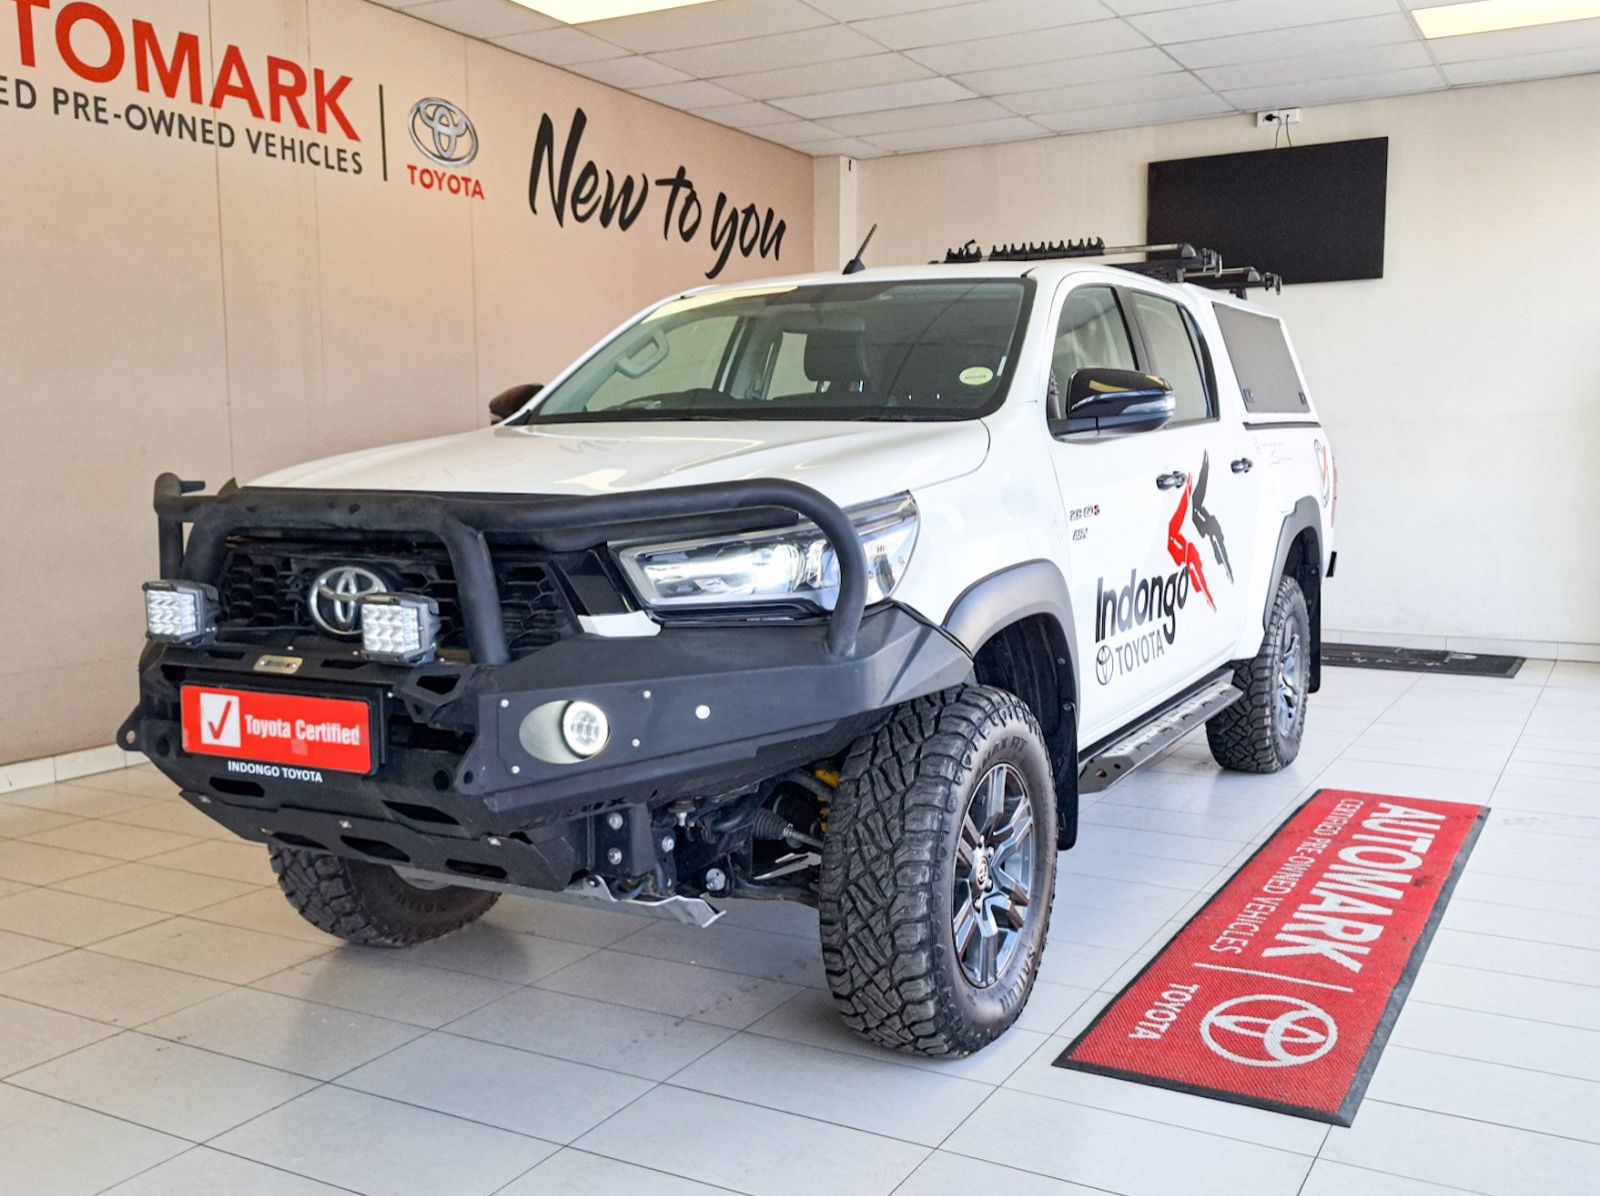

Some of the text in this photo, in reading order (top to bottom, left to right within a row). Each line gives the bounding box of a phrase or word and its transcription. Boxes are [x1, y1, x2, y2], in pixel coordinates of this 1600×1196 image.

[10, 0, 361, 143] TOMARK
[52, 87, 235, 149] PRE-OWNED
[246, 128, 363, 174] VEHICLES
[407, 164, 485, 200] TOYOTA
[528, 107, 787, 280] New to you
[1094, 566, 1189, 645] Indongo
[1115, 629, 1165, 676] TOYOTA
[244, 713, 361, 746] Toyota Certified
[227, 760, 323, 783] INDONGO TOYOTA
[1261, 802, 1447, 974] AUTOMARK
[1262, 836, 1332, 895] PRE-OWNED
[1208, 897, 1284, 955] VEHICLES
[1127, 982, 1200, 1041] TOYOTA
